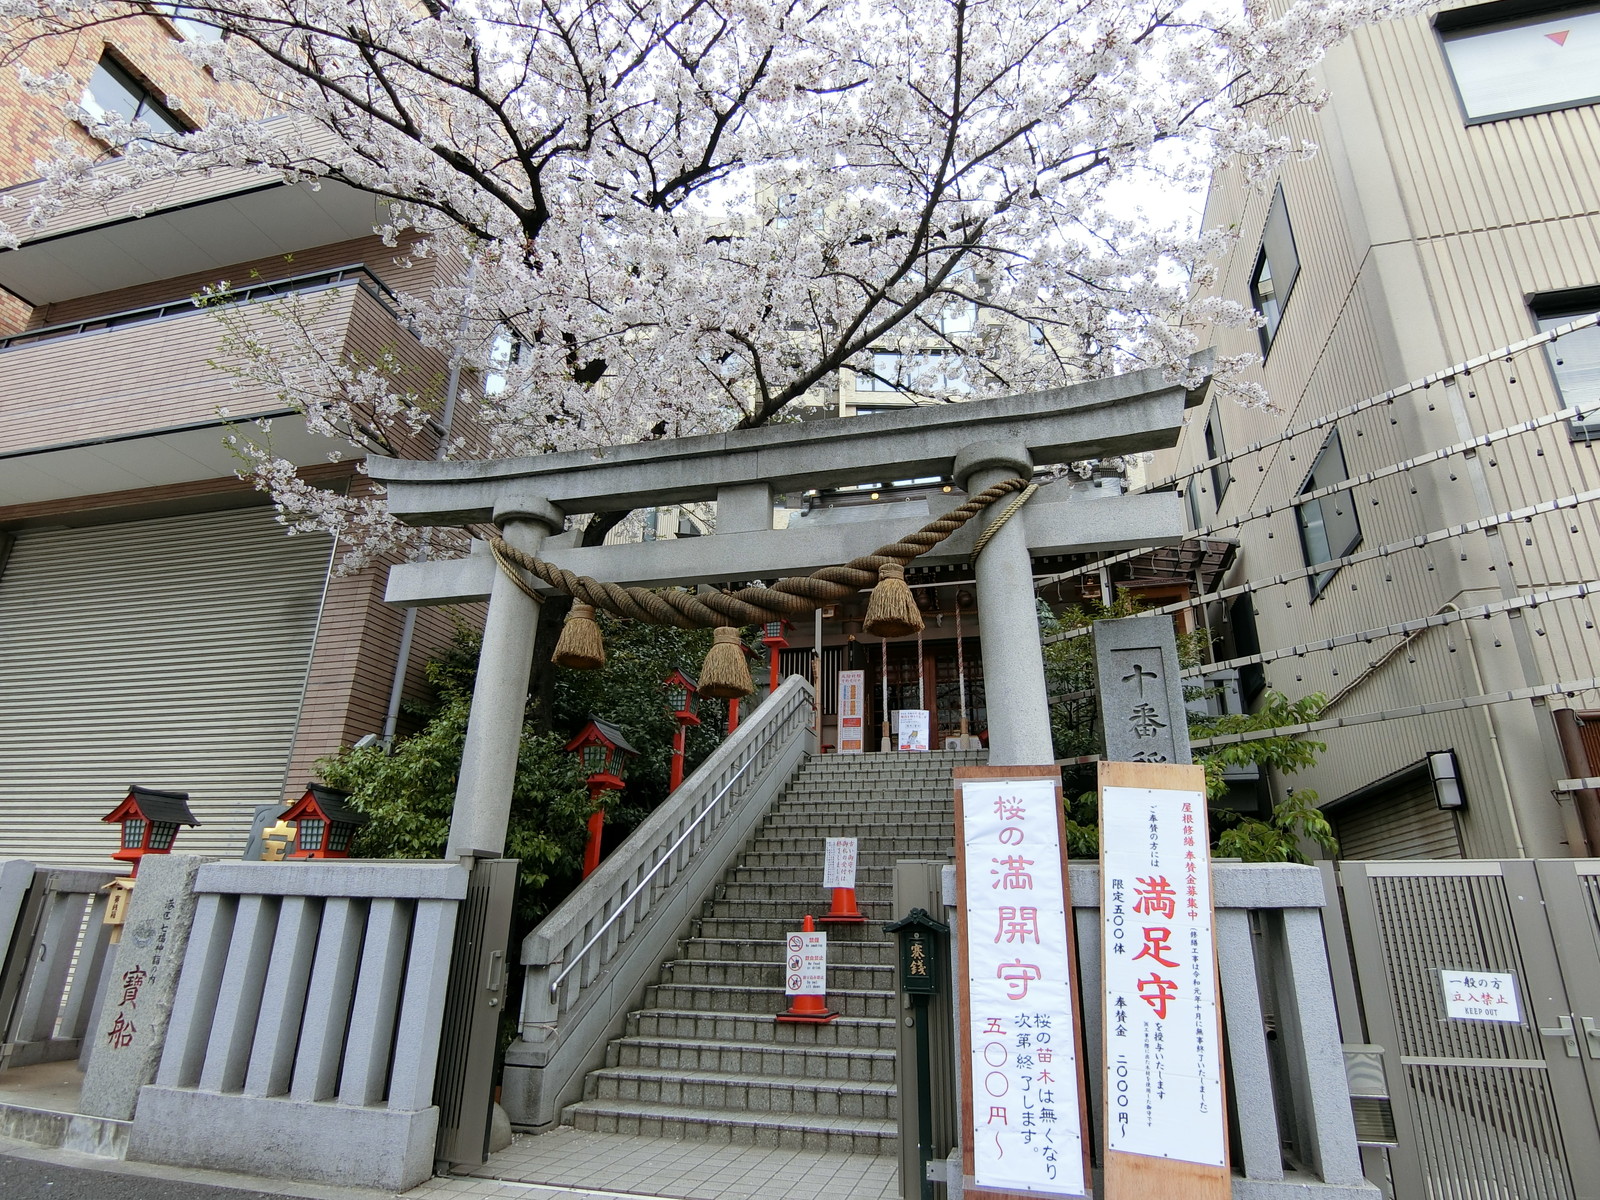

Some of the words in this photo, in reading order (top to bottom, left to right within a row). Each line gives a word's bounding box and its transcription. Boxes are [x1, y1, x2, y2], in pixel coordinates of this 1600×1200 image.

[1149, 805, 1159, 867] ご奉賛の方には
[1181, 802, 1195, 847] 屋根修繕
[990, 794, 1042, 1001] 桜の満開守
[1184, 849, 1198, 921] 奉賛金募集中
[909, 943, 927, 976] 賽銭
[1131, 875, 1180, 1020] 満足守
[1449, 976, 1503, 990] 一般の方
[1452, 991, 1509, 1006] 立入禁止
[1464, 1007, 1483, 1016] KEEP
[1484, 1008, 1499, 1017] OUT
[1114, 996, 1128, 1037] 奉賛金
[1014, 1013, 1040, 1154] 次第終了します。
[1154, 1022, 1166, 1100] を授与いたします
[1034, 1012, 1058, 1181] 桜の苗木は無くなり
